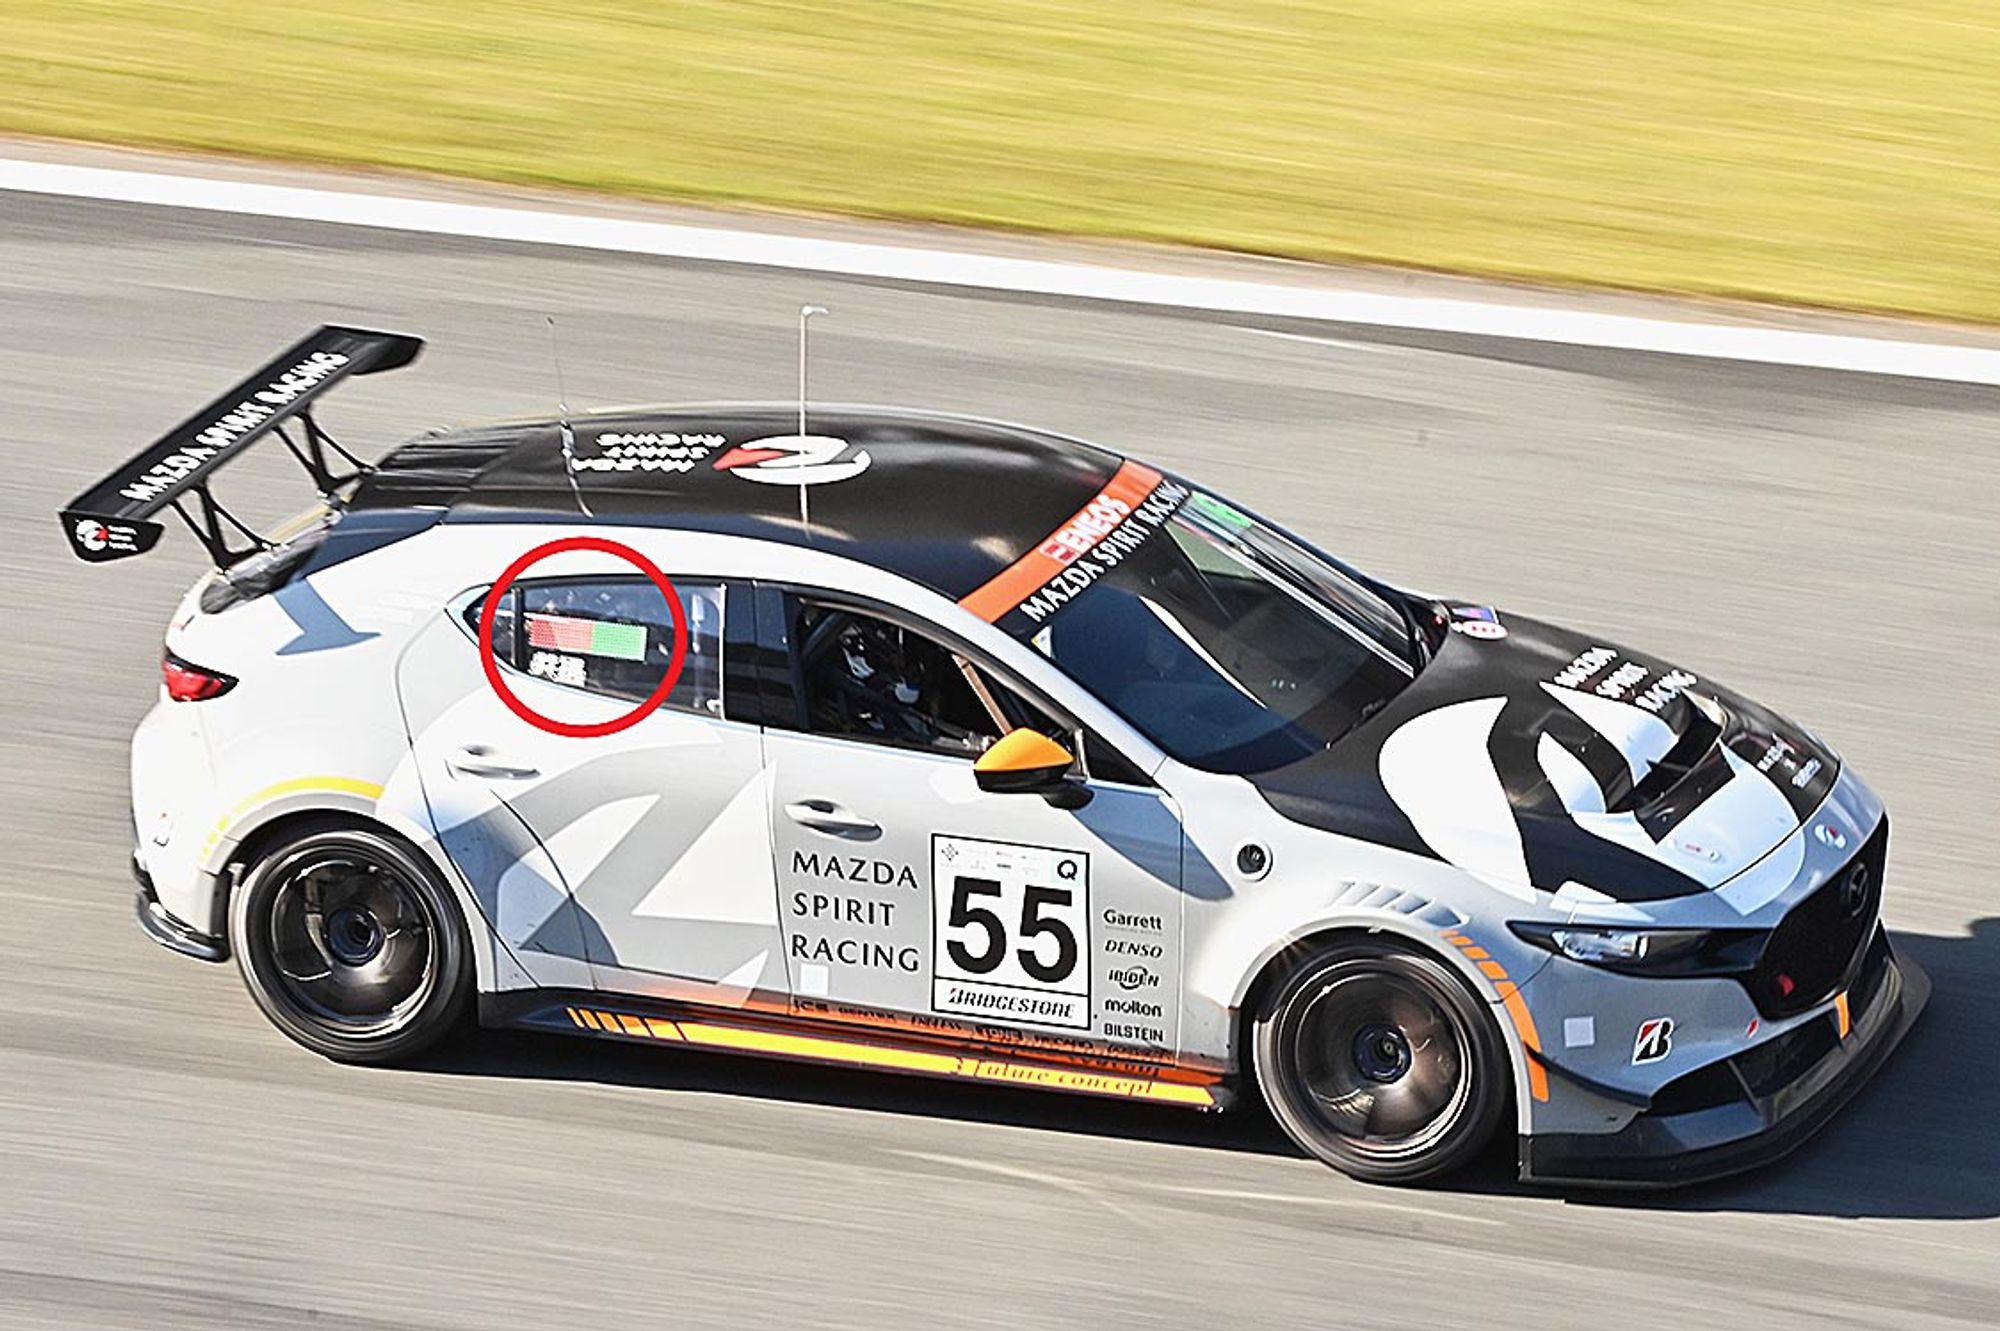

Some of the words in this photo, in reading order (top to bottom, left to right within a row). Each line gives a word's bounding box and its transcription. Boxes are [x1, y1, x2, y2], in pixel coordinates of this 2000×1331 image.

[118, 446, 218, 501] MAZDA
[1055, 494, 1132, 549] ENEOS
[1019, 559, 1105, 622] MAZDA
[1091, 517, 1151, 567] SPIRIT
[792, 850, 918, 889] MAZDA
[1057, 859, 1077, 881] Q
[792, 891, 895, 927] SPIRIT
[1103, 909, 1163, 930] Garrett
[947, 875, 1078, 984] 55
[792, 934, 919, 972] RACING
[1105, 939, 1163, 958] DENSO
[1108, 968, 1160, 989] IBIDEN
[948, 987, 1076, 1019] BRIDGESTONE
[1104, 1022, 1164, 1042] BILSTEIN
